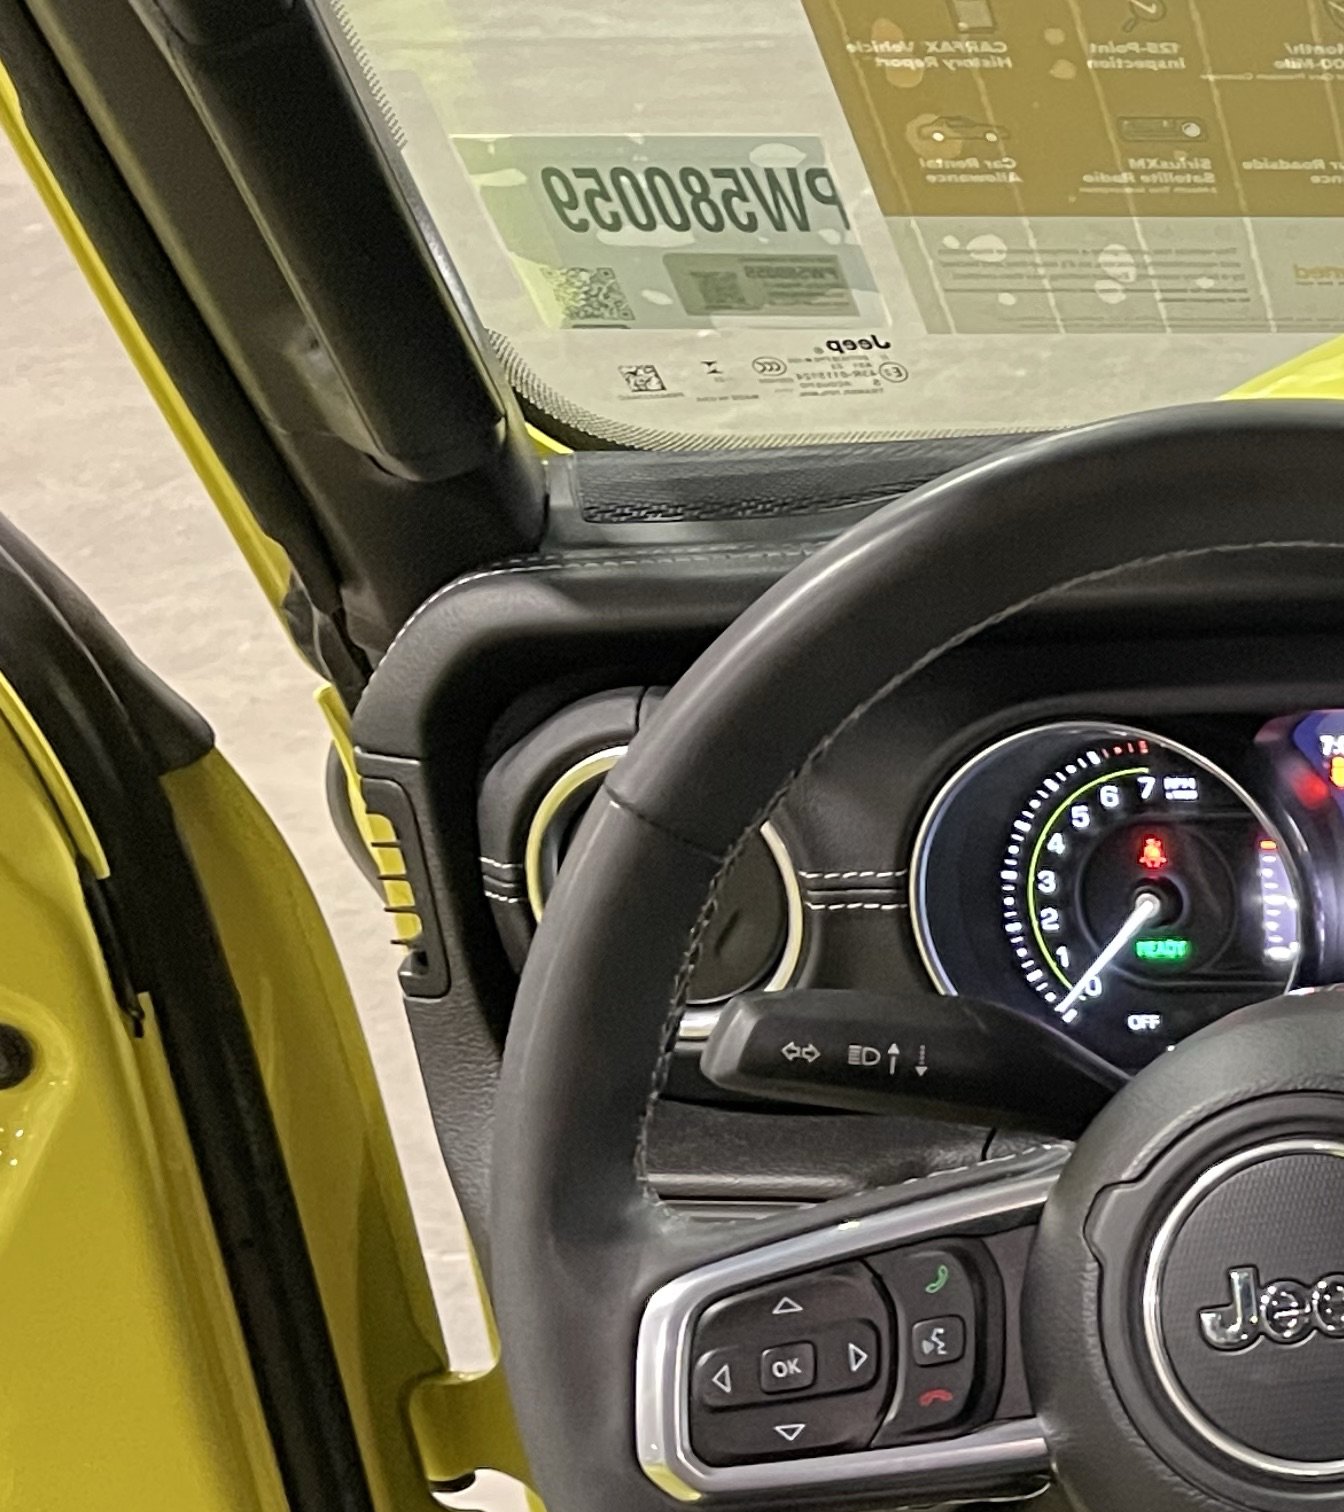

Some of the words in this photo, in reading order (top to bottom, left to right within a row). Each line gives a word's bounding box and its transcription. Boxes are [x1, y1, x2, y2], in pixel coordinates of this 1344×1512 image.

[1100, 787, 1119, 808] 6
[1137, 778, 1155, 800] 7
[1071, 807, 1090, 828] 5
[1047, 832, 1065, 855] 4
[1038, 871, 1056, 893] 3
[1040, 908, 1059, 931] 2
[1056, 946, 1070, 968] 1
[1128, 1014, 1161, 1031] OFF
[772, 1357, 802, 1379] OK
